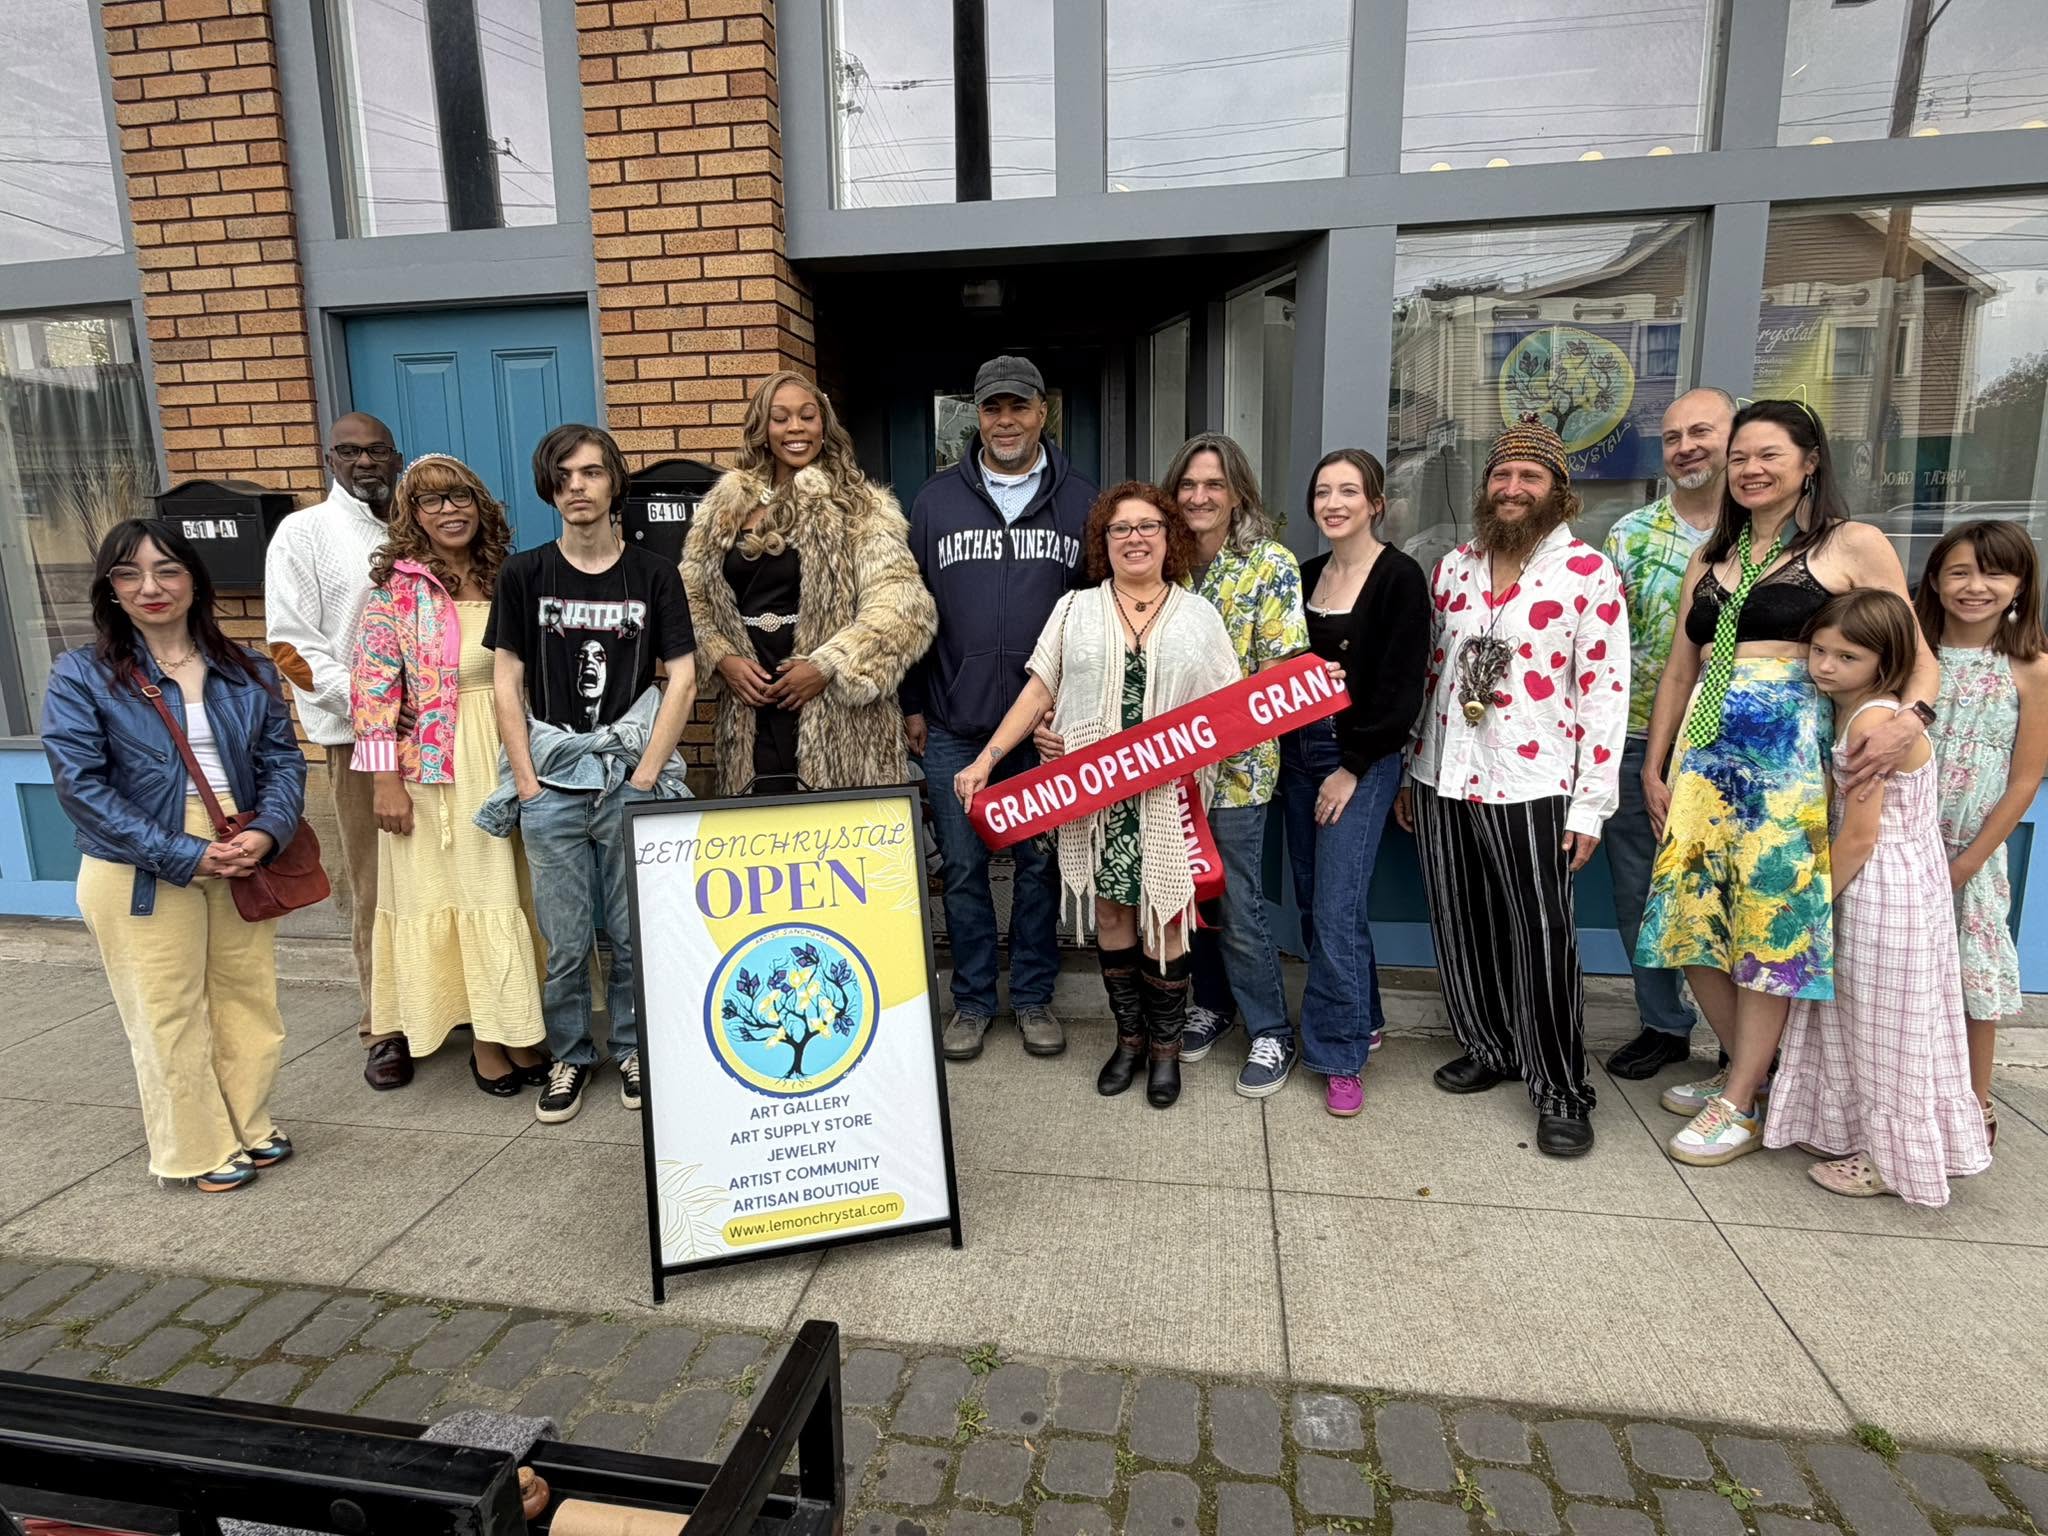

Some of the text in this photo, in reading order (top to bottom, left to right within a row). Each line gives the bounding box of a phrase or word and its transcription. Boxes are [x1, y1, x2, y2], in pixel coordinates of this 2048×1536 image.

[1757, 316, 1822, 352] rystal
[1568, 422, 1632, 472] RYSTAL
[649, 503, 684, 520] 6410
[938, 529, 1003, 570] MARTHA'S
[984, 773, 1077, 834] GRAND
[1079, 715, 1217, 795] OPENING
[635, 823, 906, 865] LEMONCHRYSTAL
[695, 857, 867, 919] OPEN
[750, 1094, 850, 1120] ART GALLERY
[730, 1113, 873, 1146] ART SUPPLY STORE
[767, 1140, 837, 1162] JEWELRY
[729, 1155, 881, 1191] ARTIST COMMUNITY
[733, 1177, 880, 1213] ARTISAN BOUTIQUE
[729, 1200, 899, 1239] Www.lemonchrystal.com
